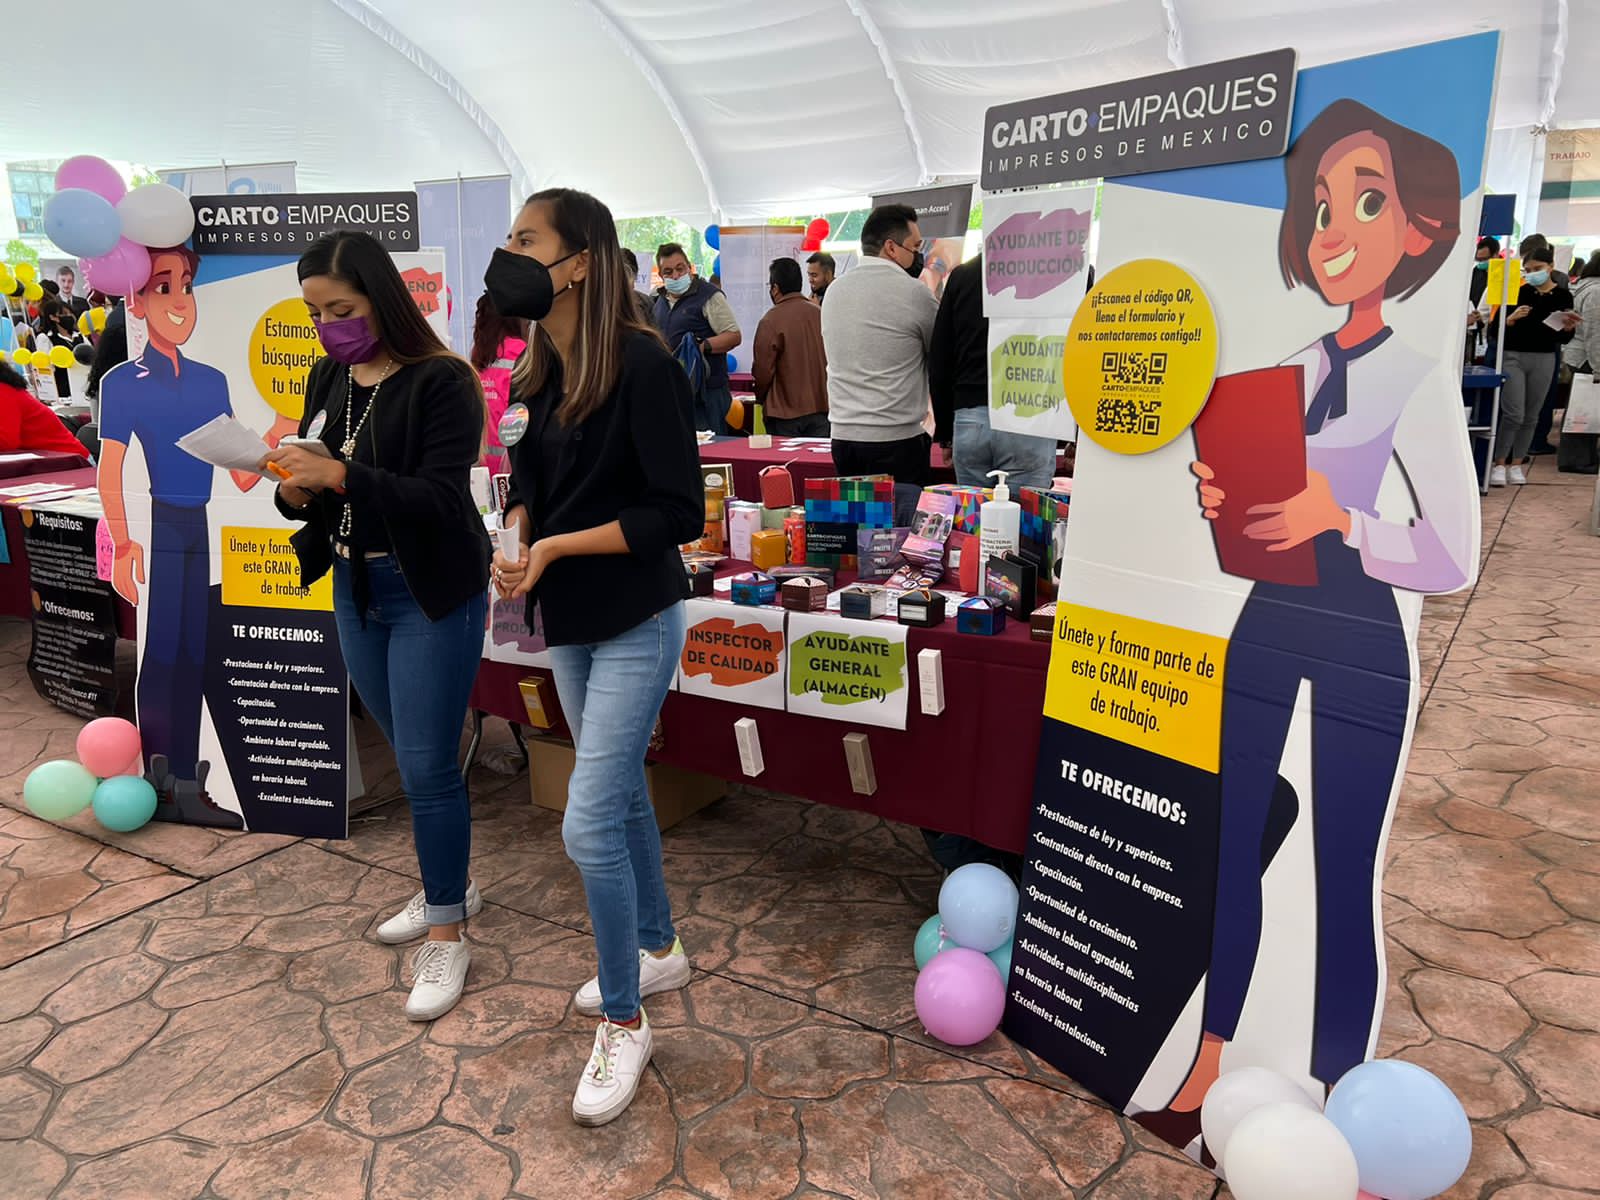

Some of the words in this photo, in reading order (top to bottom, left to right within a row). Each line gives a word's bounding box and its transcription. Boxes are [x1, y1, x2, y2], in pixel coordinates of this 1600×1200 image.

[991, 108, 1088, 149] CARTO
[1098, 73, 1278, 132] EMPAQUES
[989, 145, 1103, 173] IMPRESOS
[1118, 138, 1146, 156] DE
[1161, 119, 1273, 150] MEXICO
[198, 206, 279, 226] CARTO
[287, 203, 410, 225] EMPAQUES
[199, 232, 295, 244] IMPRESOS
[987, 230, 1062, 251] AYUDANTE
[1066, 228, 1087, 245] DE
[988, 255, 1084, 276] PRODUCCIÓN
[1133, 290, 1142, 304] el
[1144, 289, 1173, 306] código
[1176, 288, 1194, 304] QR,
[1095, 310, 1116, 323] llena
[1118, 309, 1127, 322] el
[1129, 308, 1176, 323] formulario
[1179, 313, 1185, 325] y
[265, 317, 317, 340] Estamos
[1078, 332, 1093, 341] nos
[1095, 331, 1157, 342] contactaremos
[1160, 327, 1202, 345] contigo!!
[272, 377, 285, 394] tu
[1005, 366, 1057, 384] GENERAL
[1001, 390, 1060, 413] (ALMACÉN)
[229, 535, 257, 554] Únete
[259, 543, 266, 557] y
[243, 561, 262, 573] este
[264, 560, 292, 576] GRAN
[261, 579, 273, 594] de
[232, 624, 246, 638] TE
[249, 625, 324, 643] OFRECEMOS:
[690, 629, 772, 652] INSPECTOR
[804, 634, 890, 657] AYUDANTE
[1058, 615, 1094, 647] Únete
[1097, 635, 1106, 654] y
[1110, 630, 1150, 662] forma
[1153, 649, 1192, 672] parte
[1196, 652, 1215, 679] de
[264, 661, 273, 670] de
[273, 661, 284, 673] ley
[284, 664, 289, 673] y
[290, 664, 325, 674] superiores.
[687, 650, 706, 664] DE
[710, 653, 775, 675] CALIDAD
[809, 657, 882, 678] GENERAL
[269, 680, 291, 691] directa
[303, 682, 310, 692] la
[311, 686, 340, 695] empresa.
[804, 679, 887, 703] (ALMACÉN)
[1071, 658, 1096, 679] este
[1100, 661, 1138, 691] GRAN
[1141, 679, 1188, 708] equipo
[1090, 690, 1106, 714] de
[1110, 698, 1160, 733] trabajo.
[279, 719, 287, 728] de
[288, 721, 325, 731] crecimiento.
[275, 737, 297, 747] laboral
[297, 740, 331, 751] agradable.
[286, 757, 341, 770] multidisciplinarias
[261, 773, 284, 784] horario
[284, 775, 308, 786] laboral.
[292, 795, 335, 808] instalaciones.
[1061, 759, 1078, 783] TE
[1082, 768, 1187, 826] OFRECEMOS:
[1036, 804, 1088, 835] -Prestaciones
[1089, 825, 1100, 840] de
[1101, 830, 1116, 849] ley
[1115, 841, 1124, 852] y
[1124, 844, 1173, 872] superiores.
[1033, 831, 1084, 862] -Contratación
[1085, 854, 1114, 876] directa
[1115, 870, 1130, 884] con
[1131, 873, 1141, 889] la
[1142, 883, 1184, 909] empresa.
[1034, 859, 1084, 893] Capacitación.
[1026, 884, 1078, 918] -Oportunidad
[1077, 910, 1088, 924] de
[1089, 918, 1138, 951] crecimiento.
[1022, 911, 1061, 939] -Ambiente
[1061, 930, 1091, 955] laboral
[1091, 949, 1135, 980] agradable.
[1019, 938, 1065, 971] -Actividades
[1065, 968, 1140, 1013] multidisciplinarias
[1014, 965, 1024, 976] en
[1025, 967, 1053, 993] horario
[1053, 984, 1083, 1012] laboral.
[1011, 990, 1053, 1022] -Excelentes
[1054, 1015, 1107, 1057] instalaciones.
